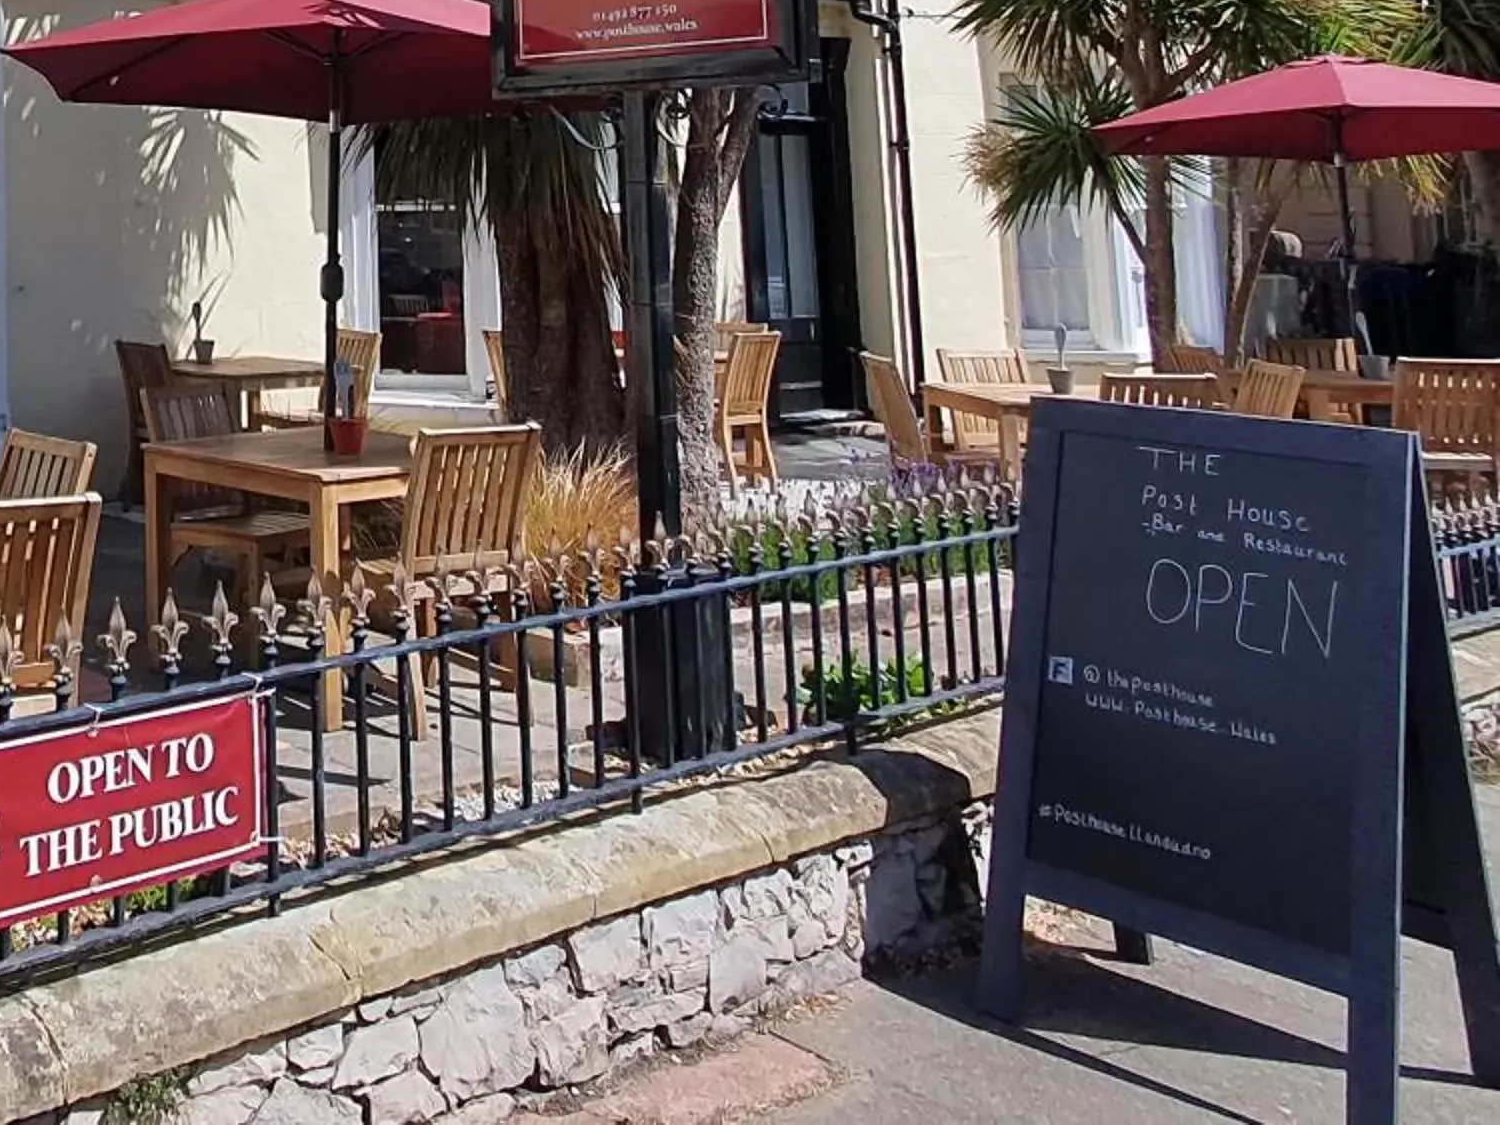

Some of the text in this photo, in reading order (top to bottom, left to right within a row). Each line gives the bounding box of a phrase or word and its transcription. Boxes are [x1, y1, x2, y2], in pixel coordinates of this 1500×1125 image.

[1137, 446, 1221, 476] THE
[1141, 484, 1197, 516] Post
[1145, 558, 1339, 659] OPEN
[47, 732, 215, 804] OPEN TO
[19, 785, 240, 877] THE PUBLIC
